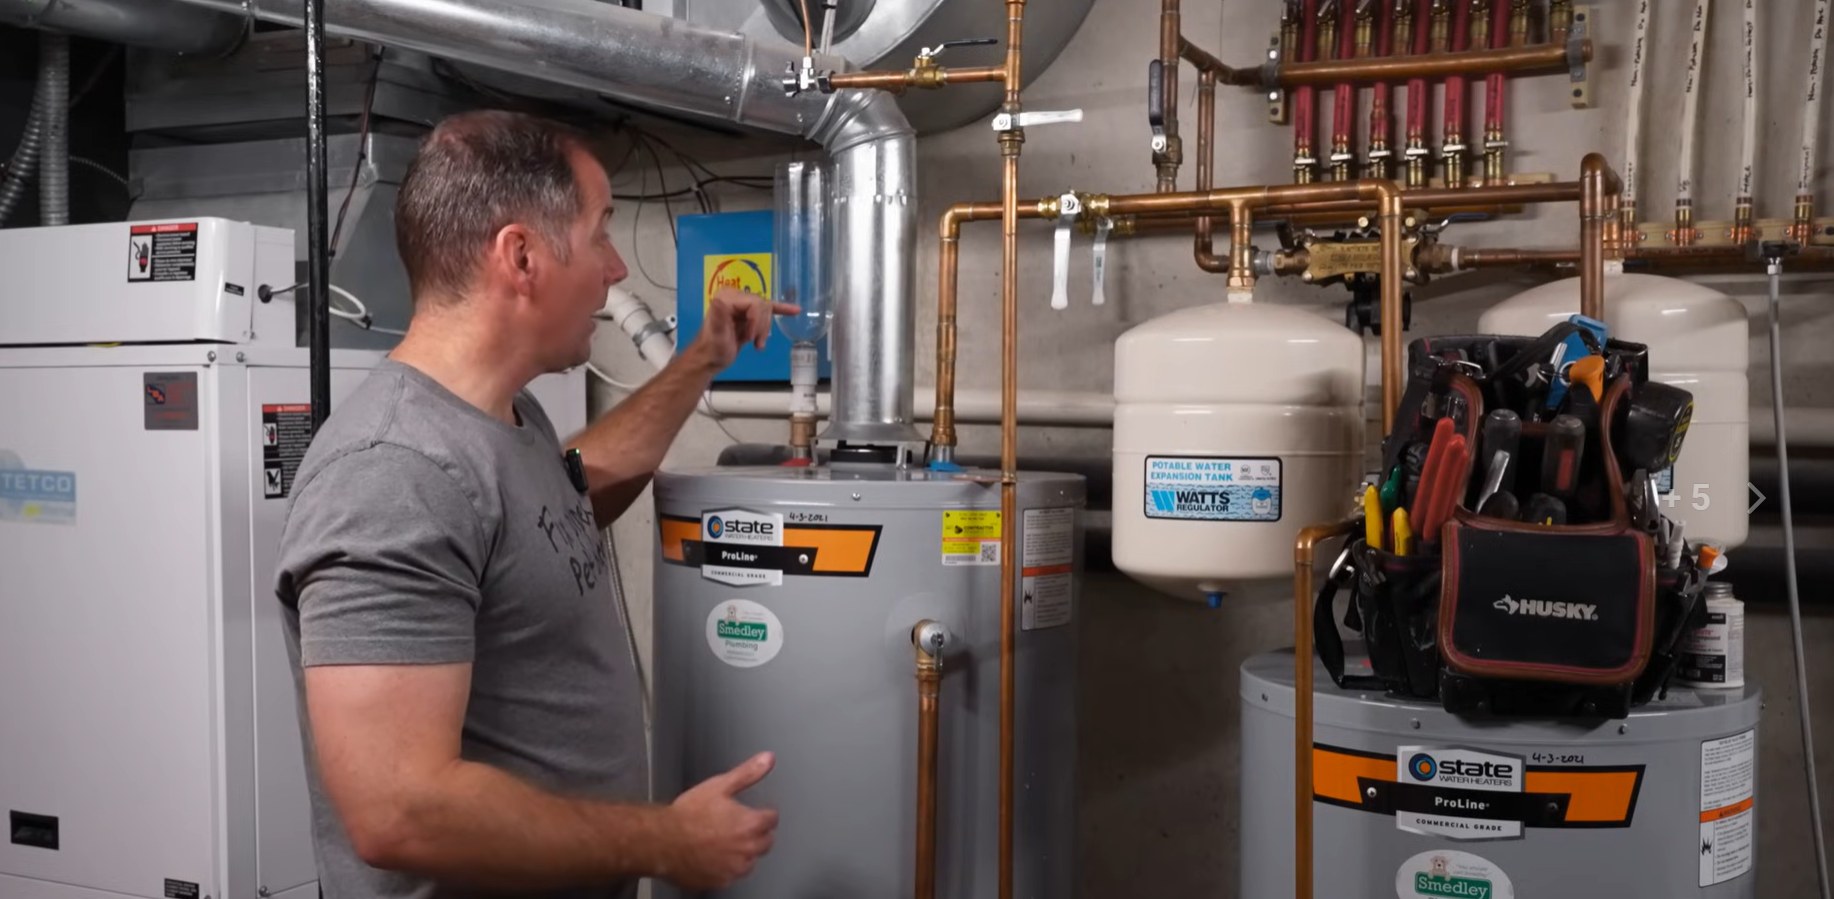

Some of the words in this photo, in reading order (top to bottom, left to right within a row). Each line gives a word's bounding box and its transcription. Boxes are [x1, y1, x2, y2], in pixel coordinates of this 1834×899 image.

[1152, 461, 1192, 471] POTABLE
[1195, 462, 1231, 471] WATER
[1, 473, 72, 493] TETCO
[1151, 472, 1202, 481] EXPANSION
[1204, 472, 1233, 482] TANK
[1176, 490, 1231, 505] WATTS
[1176, 503, 1229, 512] REGULATOR
[789, 511, 828, 523] 4-3-2021
[724, 519, 774, 535] state
[1519, 598, 1597, 620] HUSKY
[719, 622, 765, 641] Smedley
[1532, 752, 1585, 765] 4-3-2021
[1438, 759, 1513, 779] state
[1438, 775, 1470, 785] WATER
[1470, 776, 1513, 788] HEATERS
[1415, 818, 1470, 830] COMMERCIAL
[1473, 824, 1503, 832] GRADE
[1418, 876, 1488, 898] Smedley
